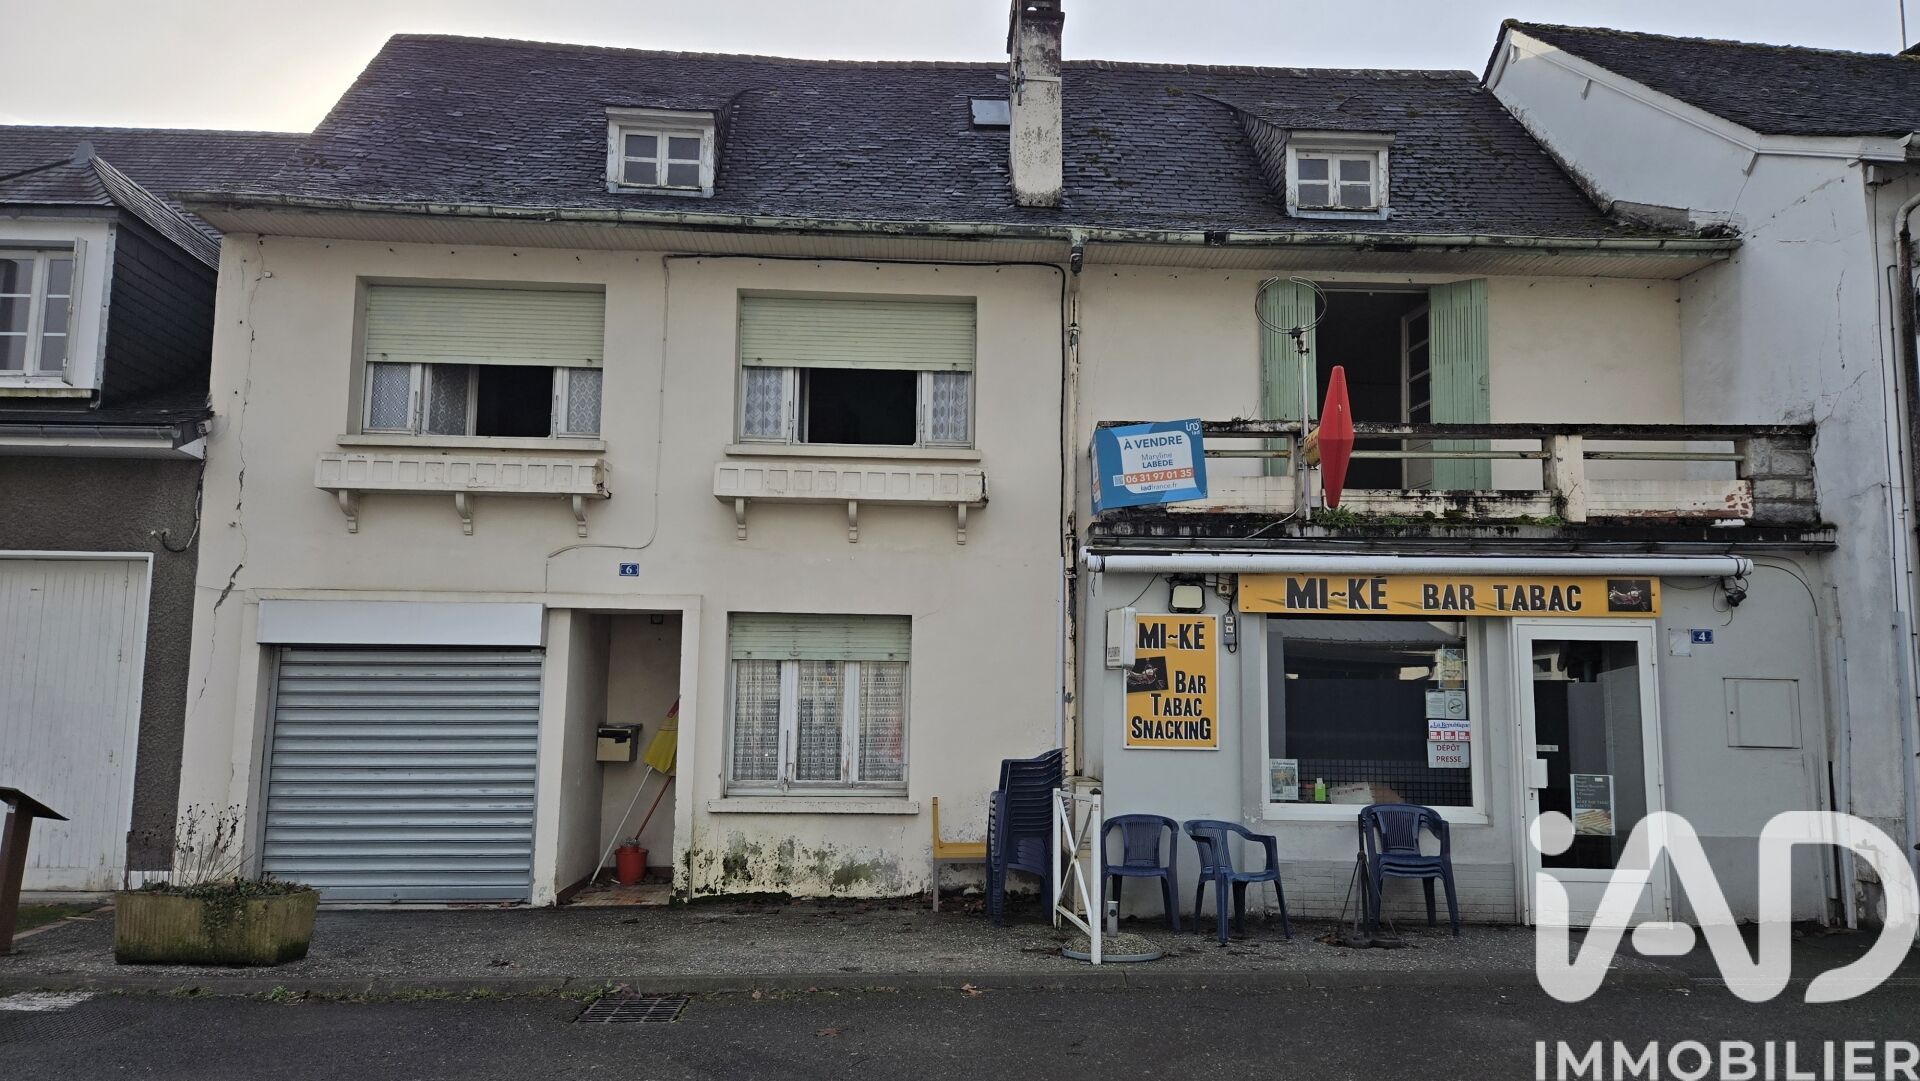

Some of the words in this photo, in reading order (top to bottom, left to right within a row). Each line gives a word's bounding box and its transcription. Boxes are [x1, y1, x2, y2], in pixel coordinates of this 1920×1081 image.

[1124, 438, 1133, 450] À
[1134, 435, 1183, 449] VENDRE
[1141, 452, 1173, 462] Maryline
[1126, 474, 1138, 483] 06
[1140, 473, 1150, 482] 31
[1152, 472, 1164, 480] 97
[1165, 470, 1178, 479] 01
[1180, 468, 1192, 477] 35
[1140, 482, 1177, 492] iadfrance.fr
[626, 565, 632, 574] 6
[1423, 583, 1476, 611] BAR
[1492, 584, 1582, 612] TABAC
[1698, 631, 1706, 642] 4
[1175, 670, 1207, 694] BAR
[1150, 692, 1203, 717] TABAC
[1131, 715, 1211, 740] SNACKING
[1436, 755, 1462, 763] PRESSE
